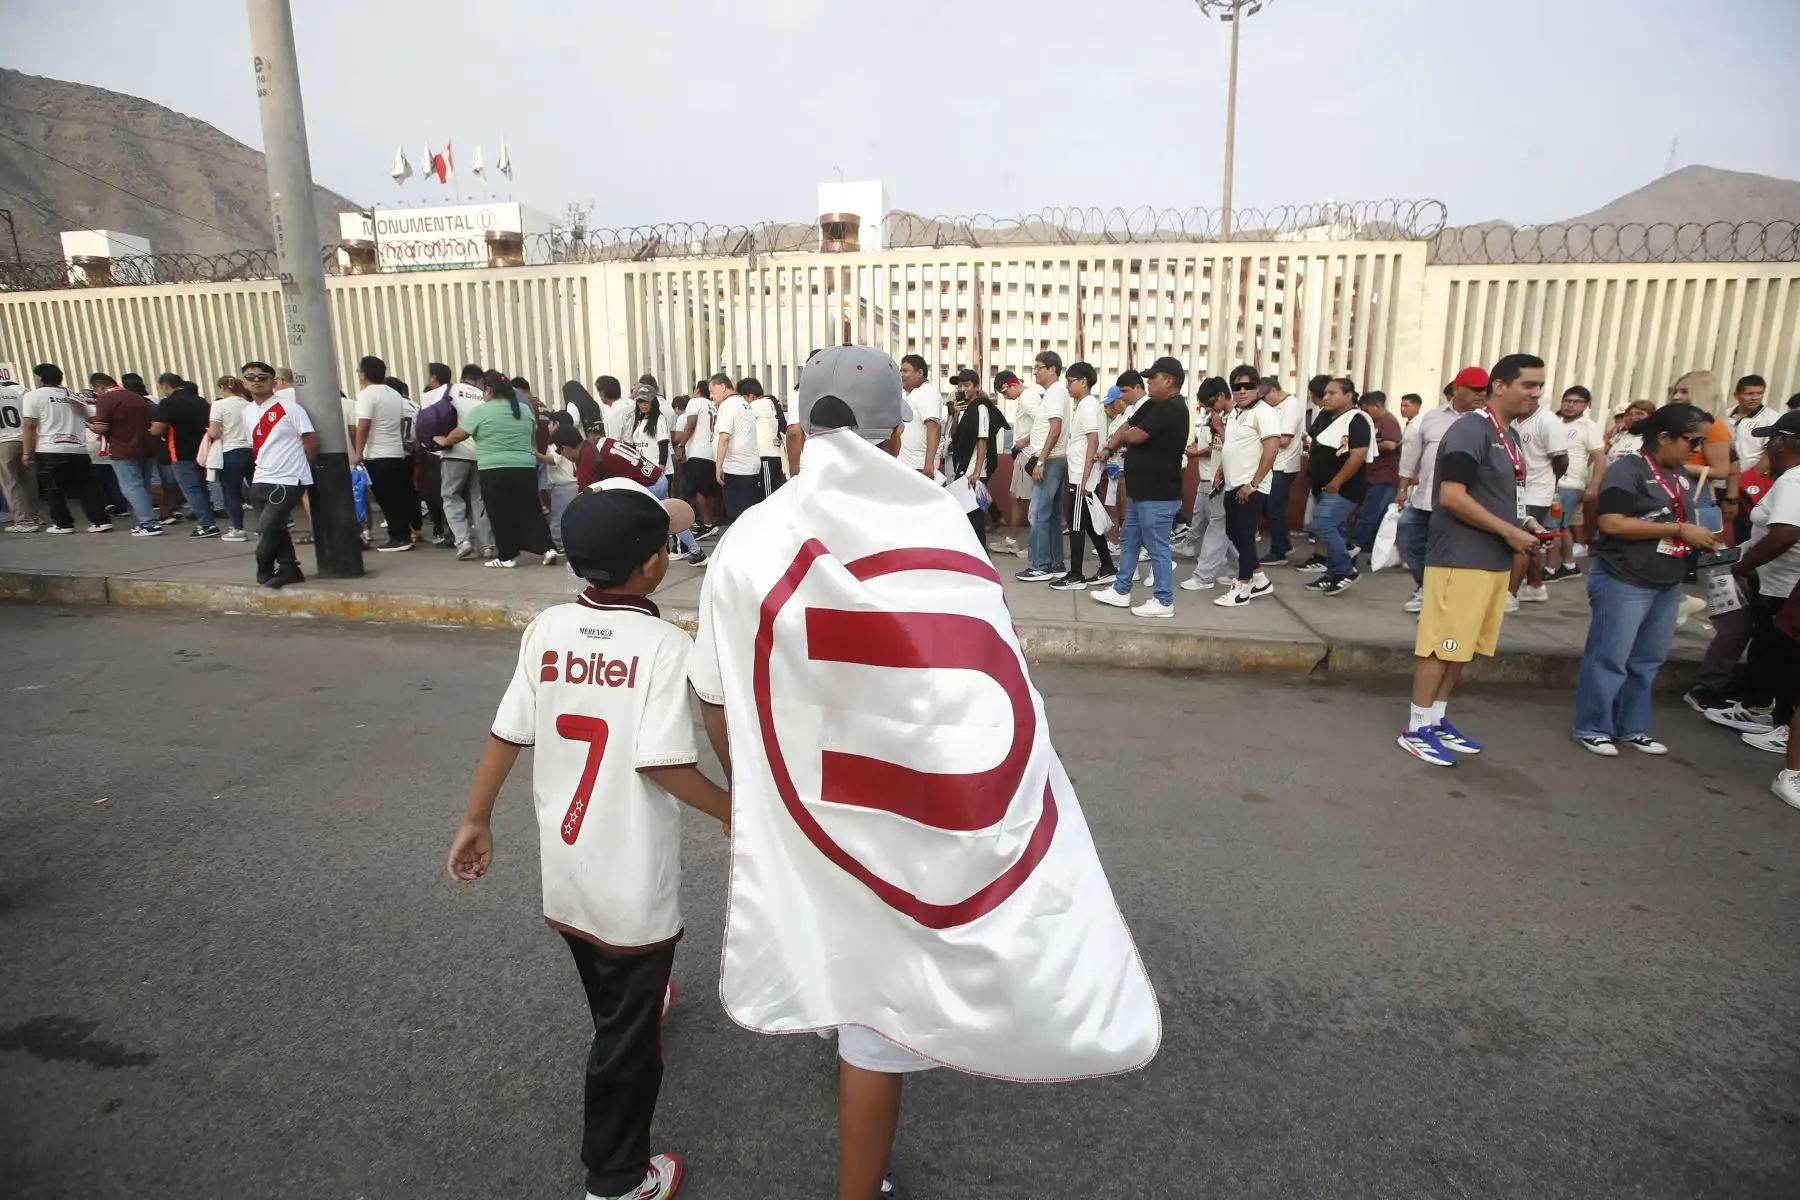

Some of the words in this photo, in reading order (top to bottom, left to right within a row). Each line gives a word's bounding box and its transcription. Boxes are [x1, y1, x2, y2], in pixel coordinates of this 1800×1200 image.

[362, 214, 474, 236] MONUMENTAL
[565, 651, 640, 689] bitel
[556, 713, 609, 845] 7
